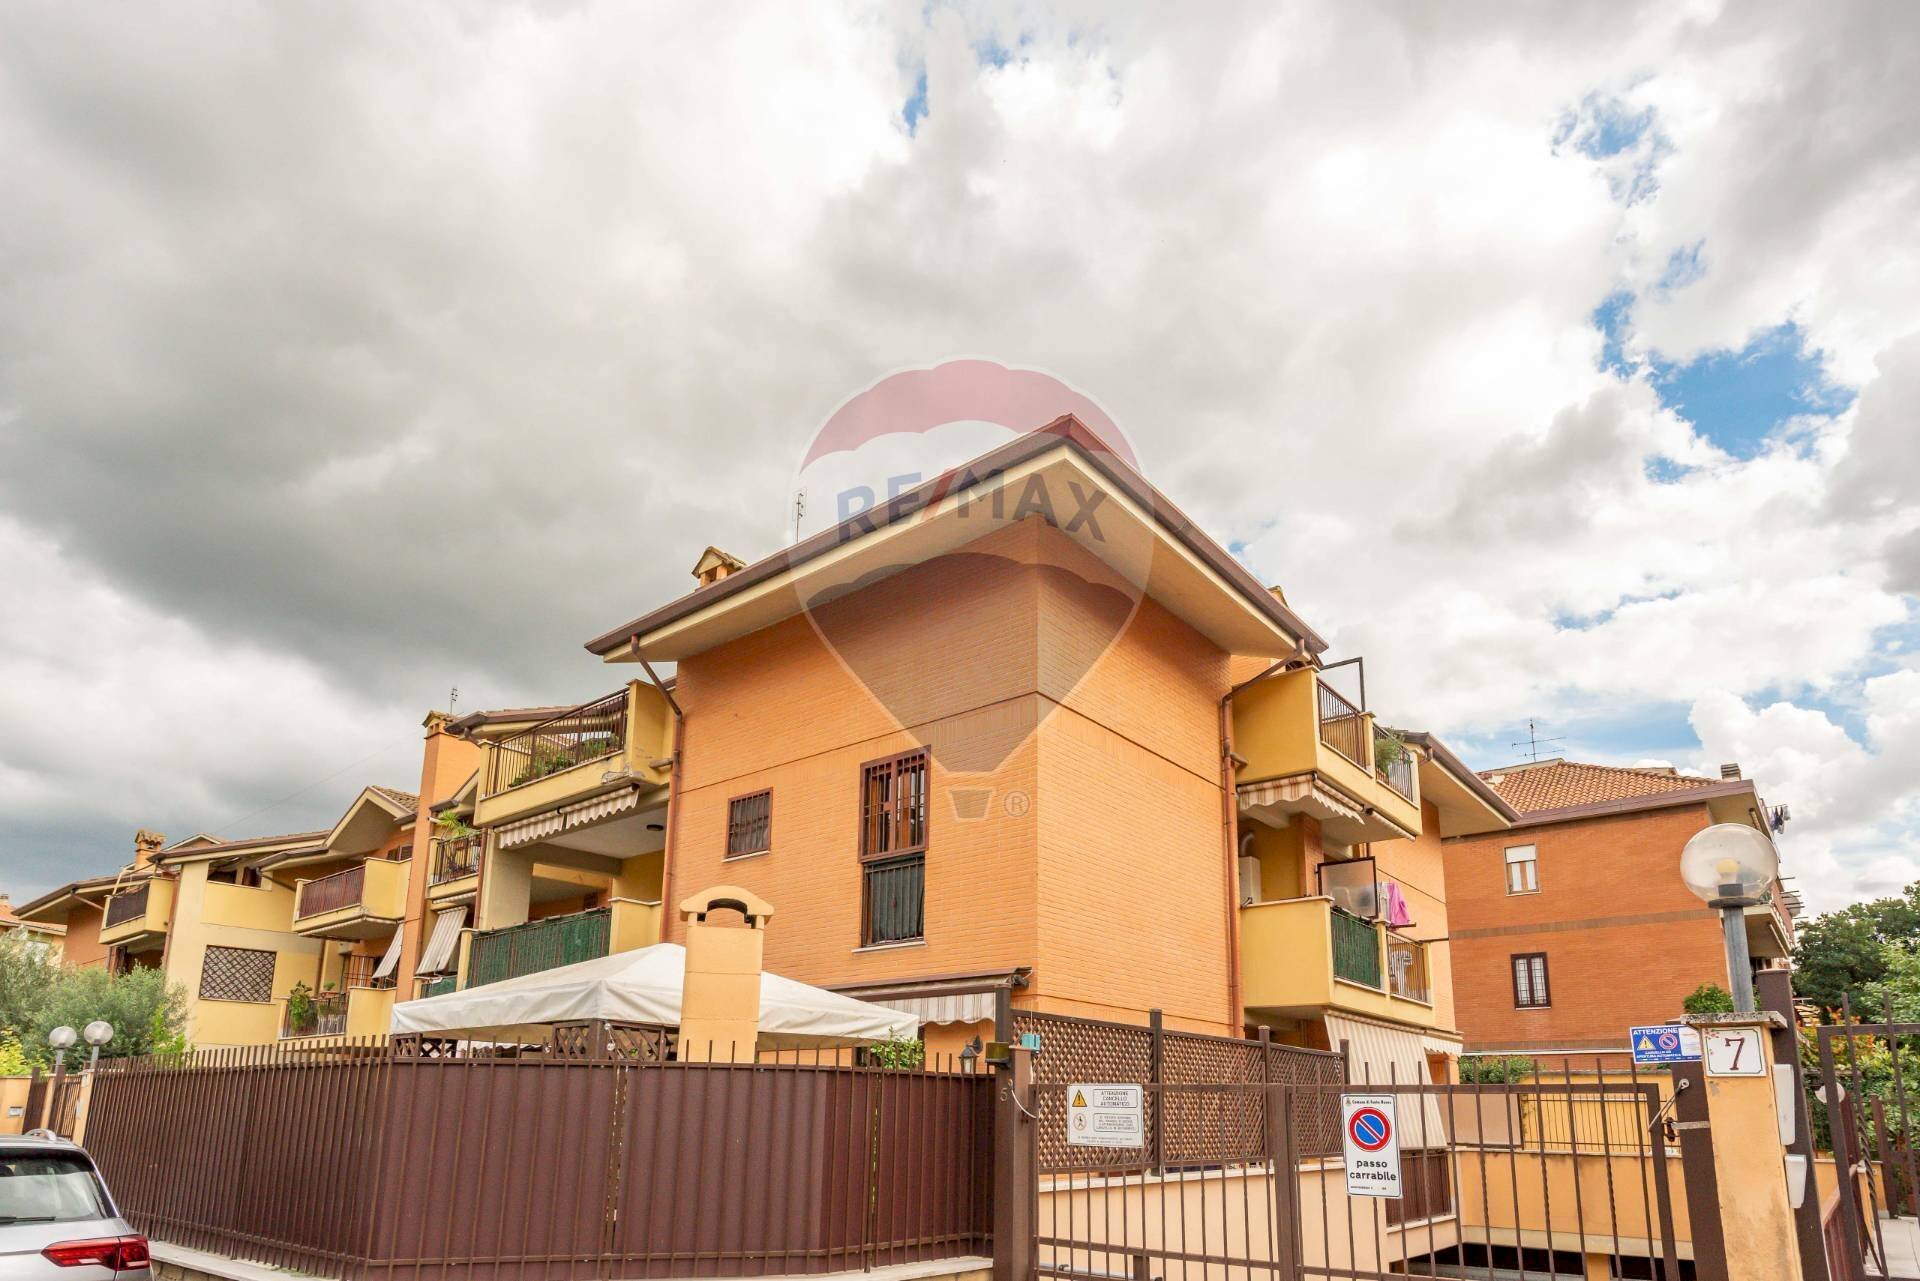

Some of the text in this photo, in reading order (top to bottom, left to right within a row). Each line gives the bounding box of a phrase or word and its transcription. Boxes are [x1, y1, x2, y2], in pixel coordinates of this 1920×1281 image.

[1633, 1027, 1678, 1035] ATTENZIONE
[1725, 1038, 1745, 1070] 7
[1356, 1160, 1388, 1169] passo
[1349, 1171, 1397, 1182] carrabile
